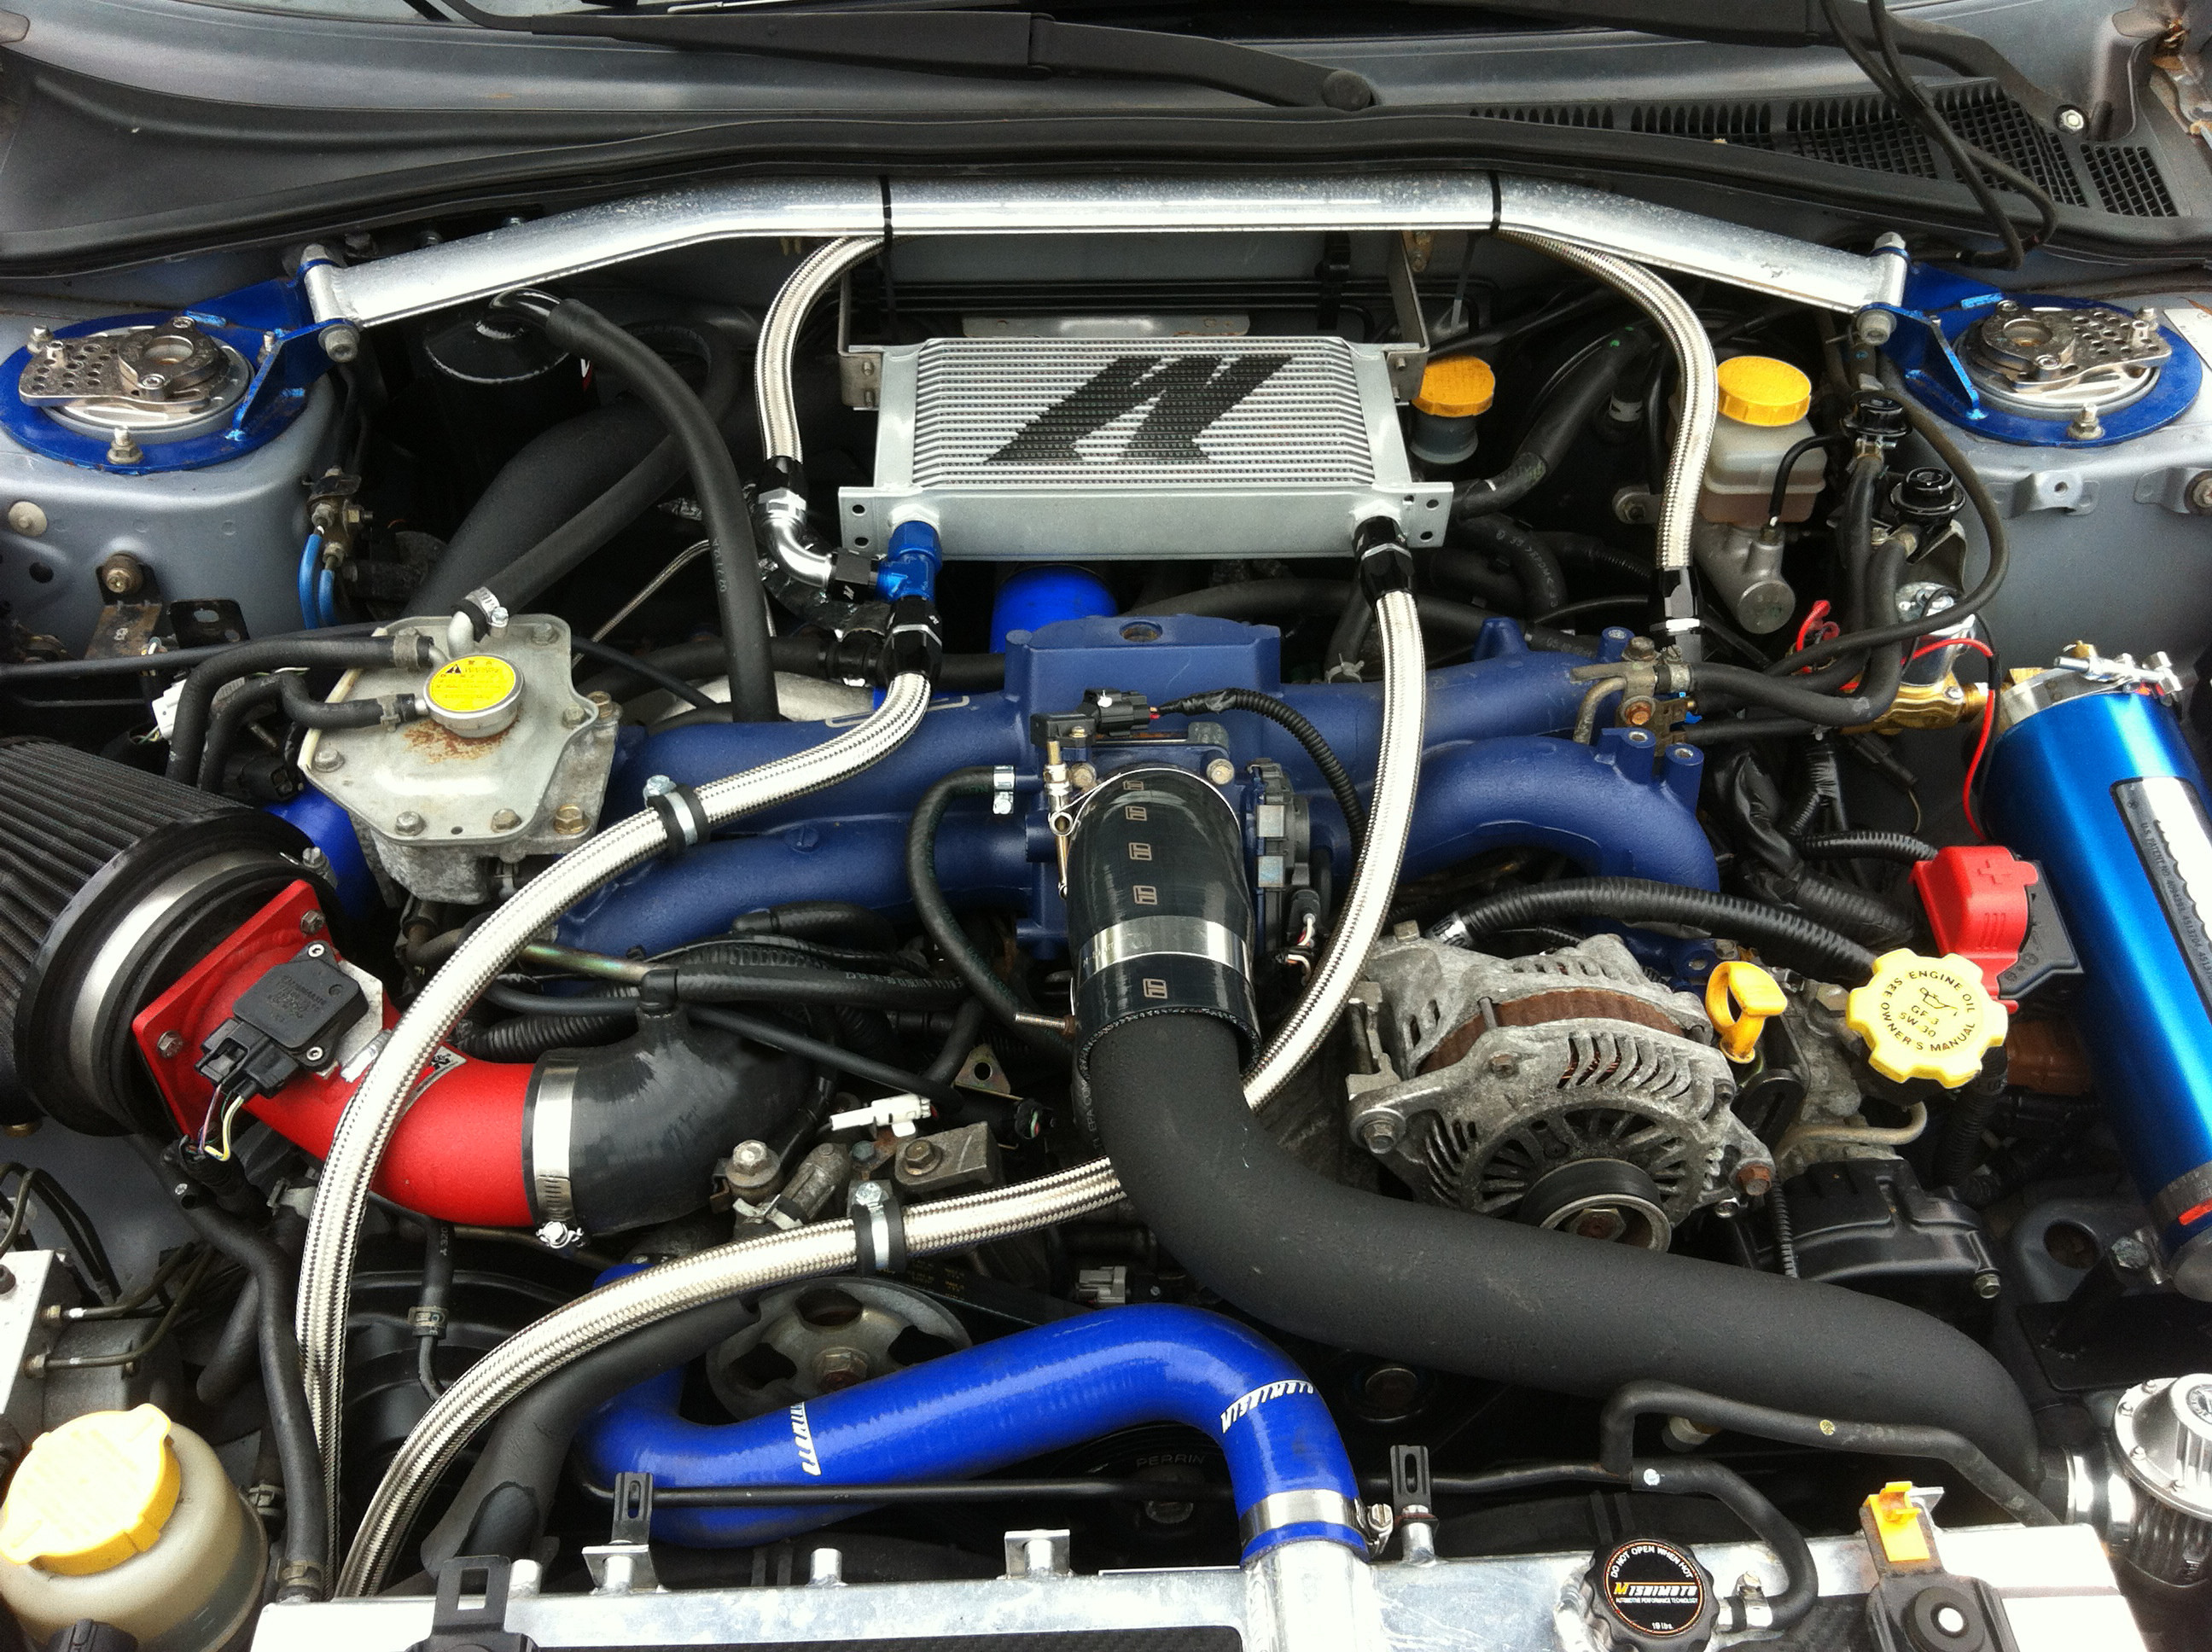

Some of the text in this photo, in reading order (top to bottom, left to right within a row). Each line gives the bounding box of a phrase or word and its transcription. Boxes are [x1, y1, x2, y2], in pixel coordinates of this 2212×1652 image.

[2147, 838, 2164, 864] PATENT
[1883, 970, 1976, 1013] SEE ENGINE OIL
[1911, 1005, 1929, 1016] GF
[1922, 1026, 1936, 1038] 30
[1930, 1023, 1976, 1051] MANUAL
[1220, 1379, 1314, 1434] MISHIMOTO
[1136, 1453, 1206, 1468] PERRIN
[1610, 1545, 1694, 1579] DO NOT OPEN WHEN HOT
[1614, 1582, 1697, 1597] MISHIMOTO
